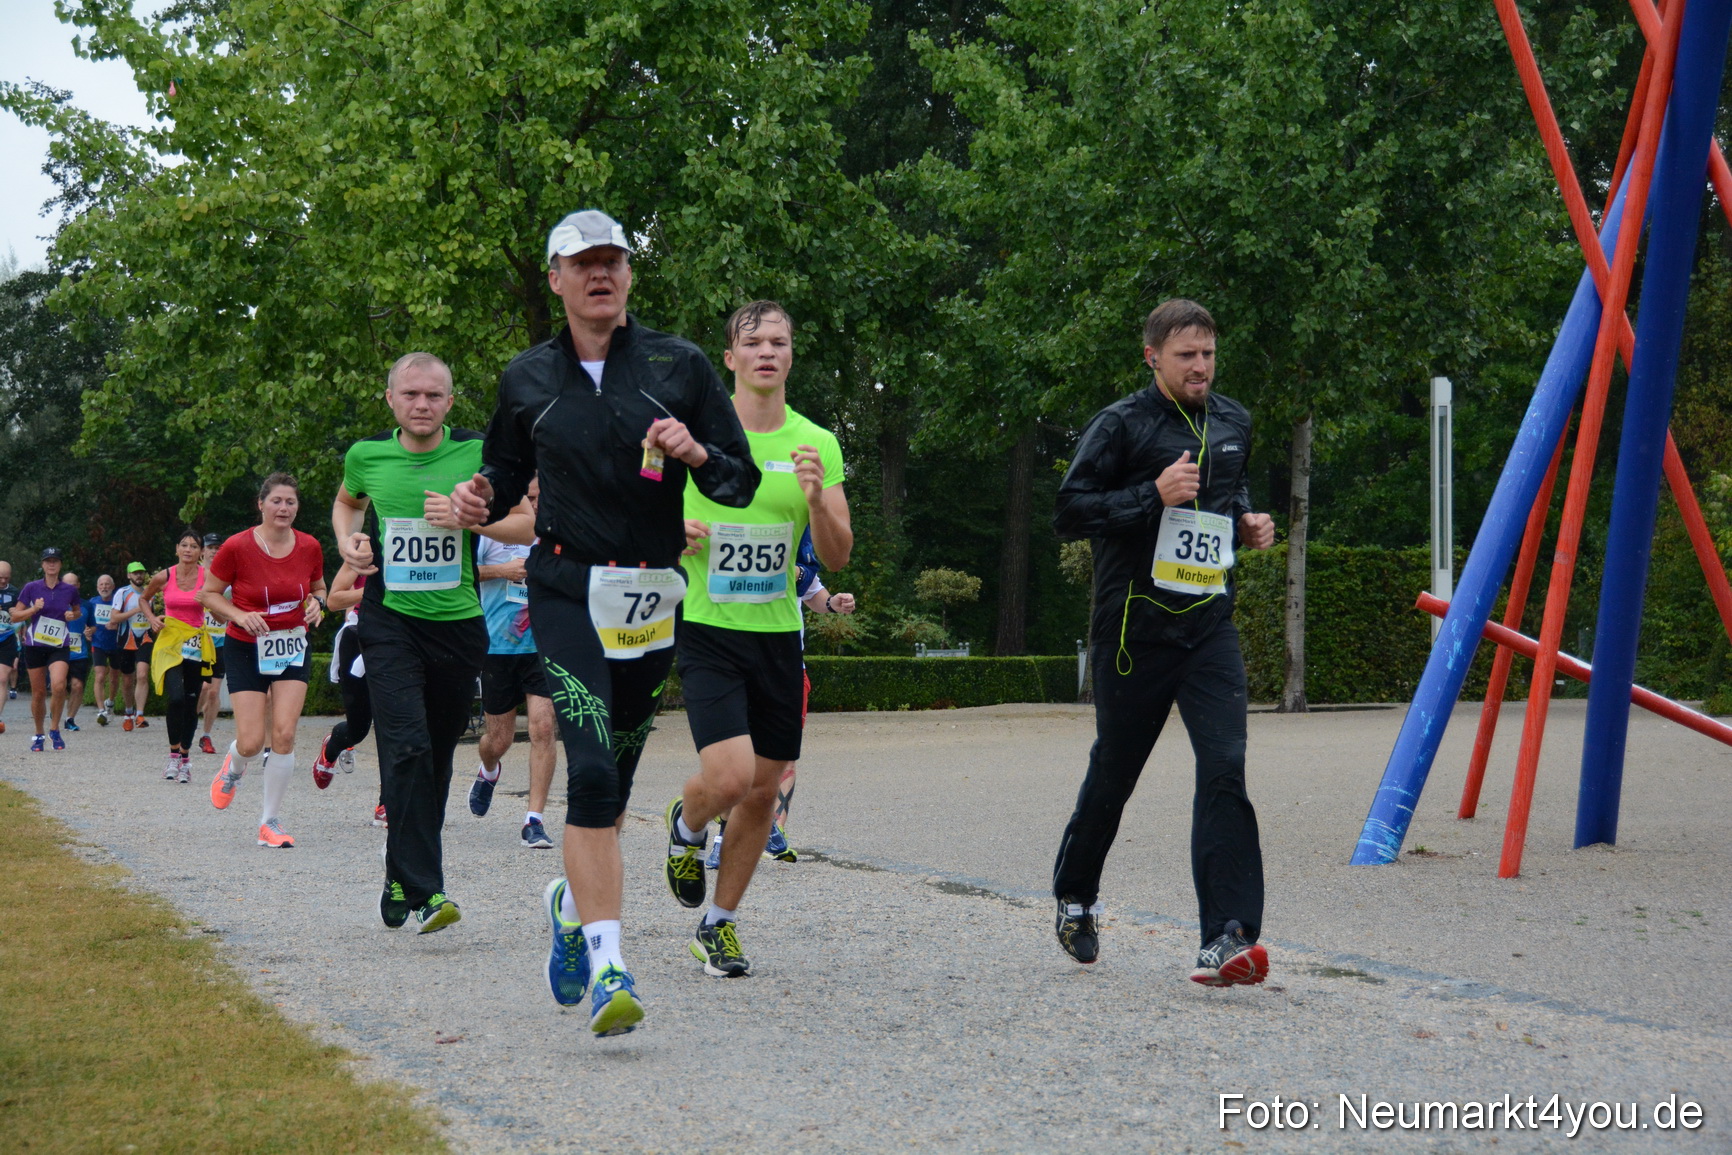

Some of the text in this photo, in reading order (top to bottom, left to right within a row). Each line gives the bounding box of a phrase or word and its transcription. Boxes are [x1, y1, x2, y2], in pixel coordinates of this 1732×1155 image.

[391, 535, 456, 563] 2056
[718, 542, 787, 573] 2353
[1175, 529, 1221, 565] 353
[409, 570, 438, 581] Peter
[729, 580, 774, 592] Valentin
[623, 591, 662, 625] 73
[43, 624, 61, 637] 167
[263, 637, 305, 657] 2060
